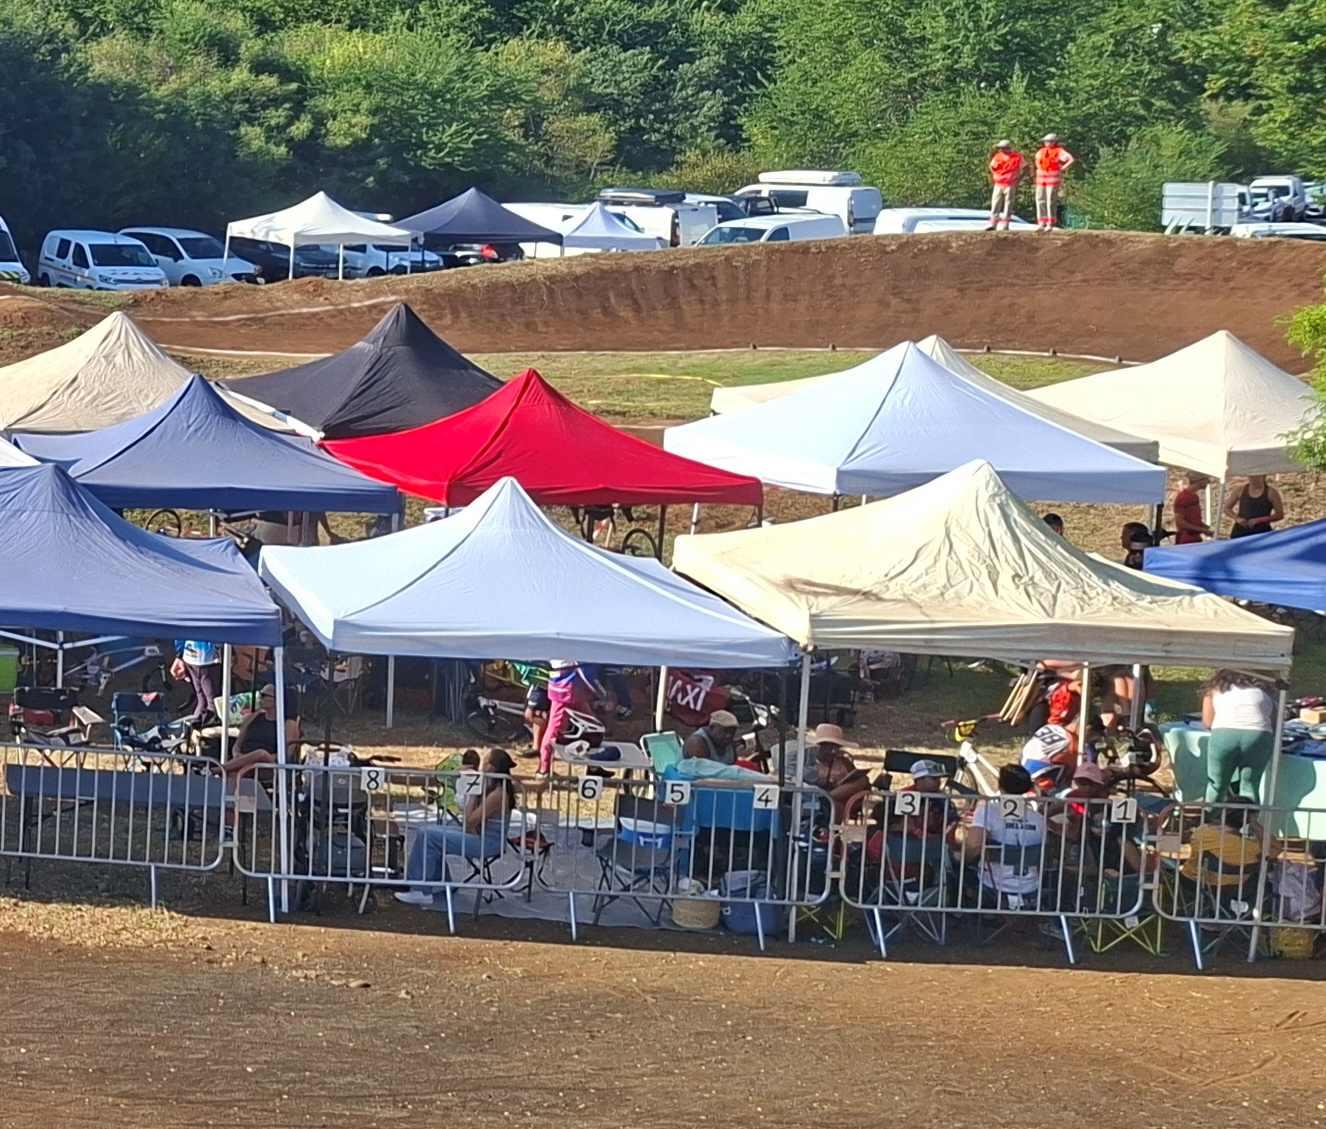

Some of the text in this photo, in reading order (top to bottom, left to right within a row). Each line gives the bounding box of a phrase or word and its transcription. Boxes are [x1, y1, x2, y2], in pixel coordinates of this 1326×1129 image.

[366, 769, 380, 791] 8
[465, 774, 481, 793] 7
[581, 779, 598, 799] 6
[669, 783, 685, 803] 5
[756, 788, 773, 808] 4
[900, 793, 916, 815] 3
[1003, 798, 1021, 818] 2
[1116, 800, 1133, 821] 1
